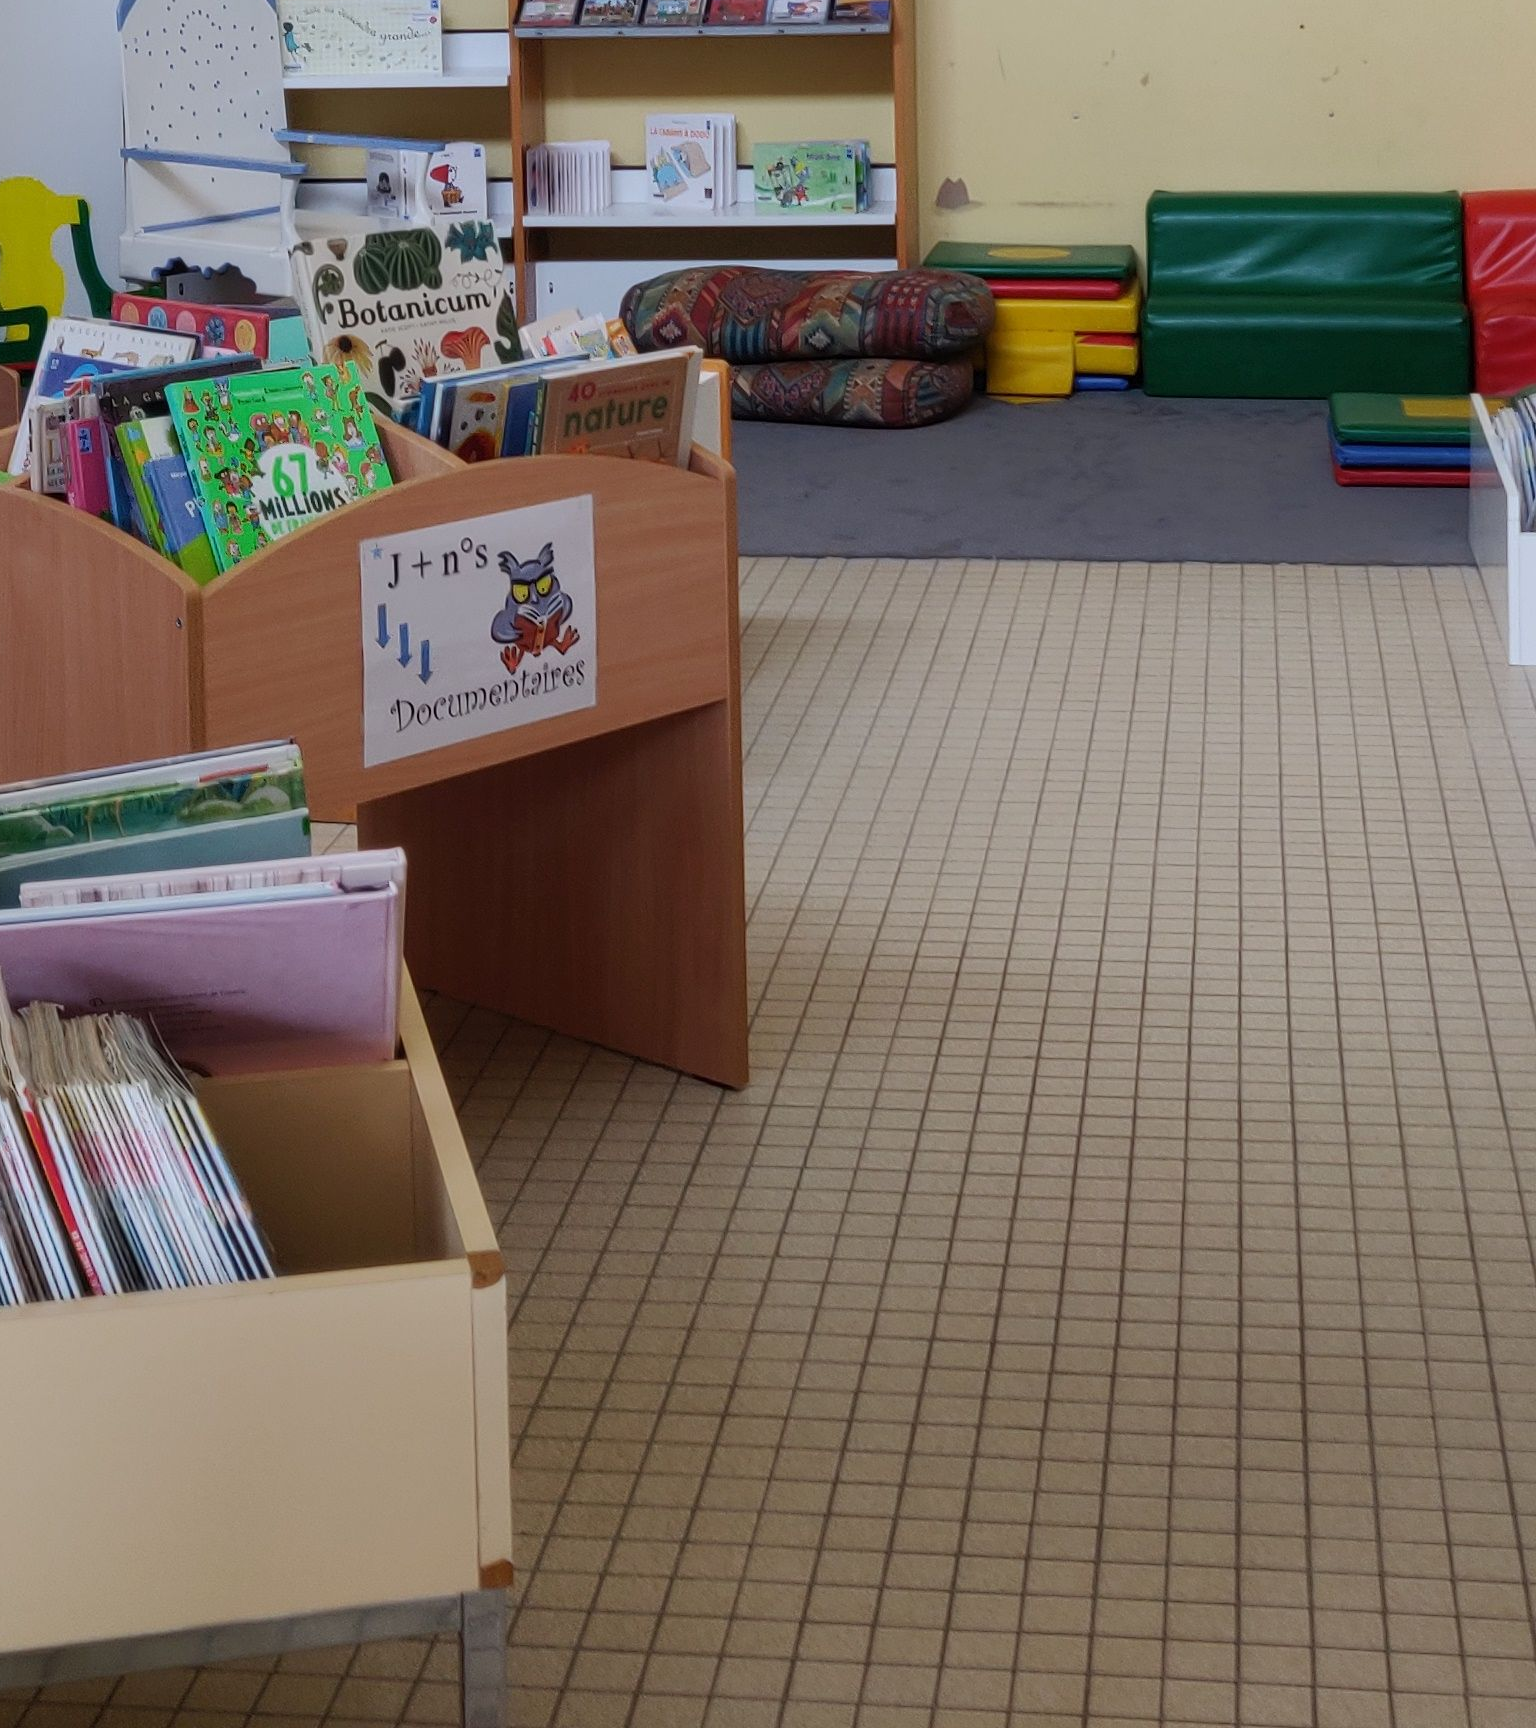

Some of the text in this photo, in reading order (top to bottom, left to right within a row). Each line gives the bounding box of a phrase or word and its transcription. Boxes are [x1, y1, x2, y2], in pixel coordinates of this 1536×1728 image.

[337, 290, 492, 329] Botanicum
[567, 381, 597, 403] 40
[562, 395, 669, 438] nature
[272, 452, 310, 498] 67
[259, 487, 349, 521] MILLIONS
[388, 536, 489, 590] J + n°s
[389, 659, 586, 734] Documentaires
